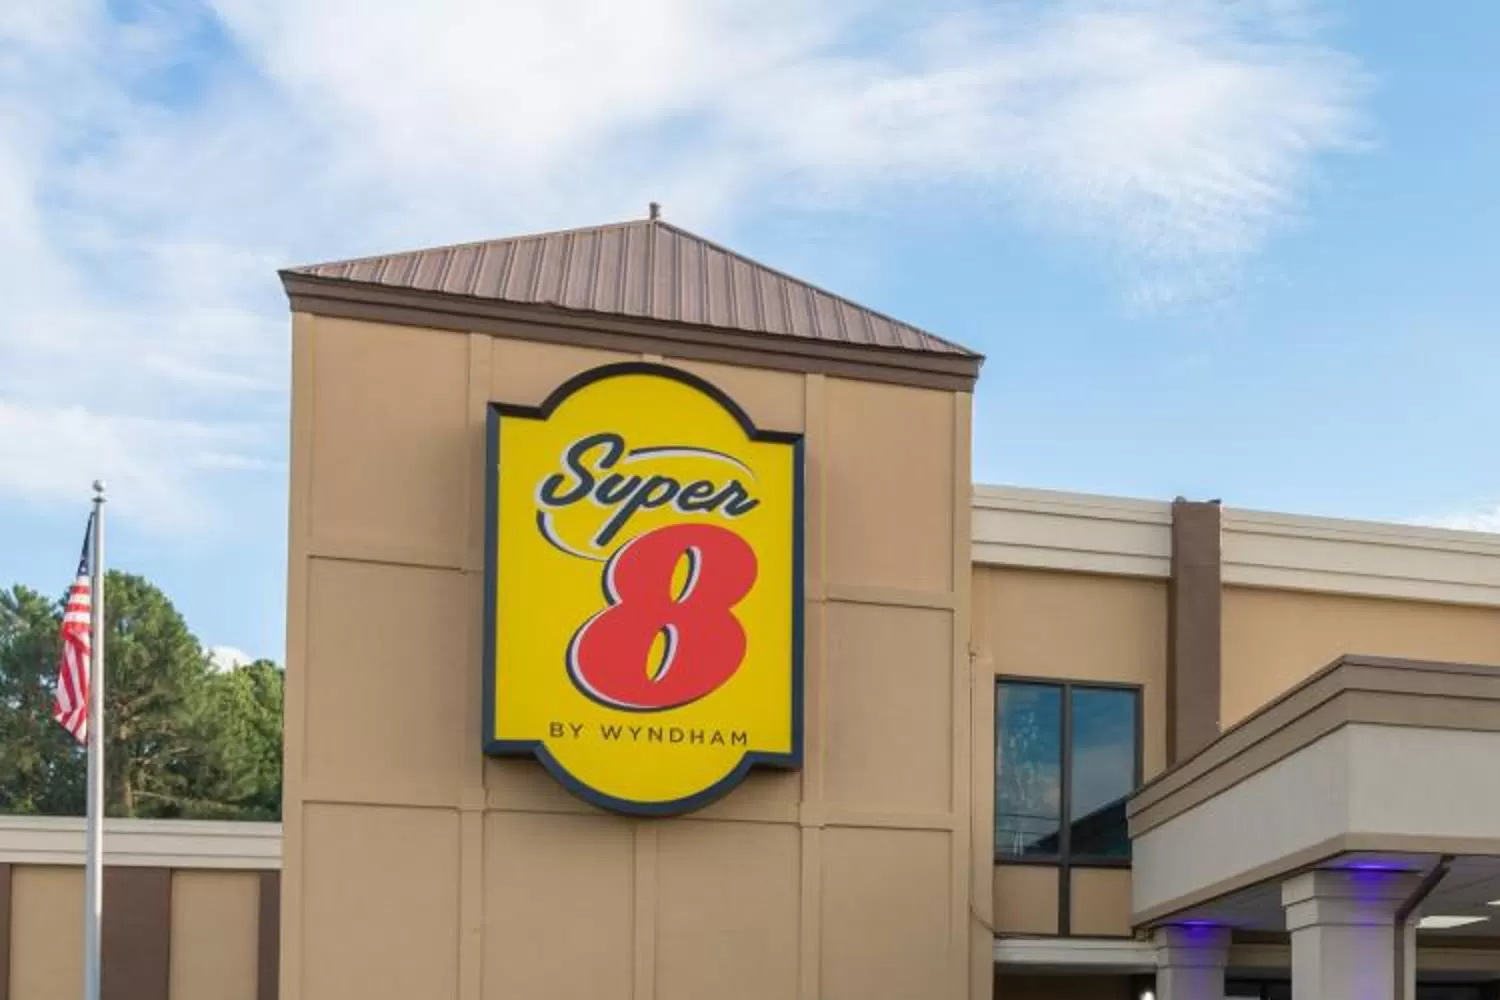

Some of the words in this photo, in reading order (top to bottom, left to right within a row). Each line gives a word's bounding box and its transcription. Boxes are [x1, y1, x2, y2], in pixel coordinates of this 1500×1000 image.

[538, 433, 761, 548] Super
[565, 522, 759, 714] 8
[549, 721, 583, 739] BY
[601, 724, 749, 746] WYNDHAM
